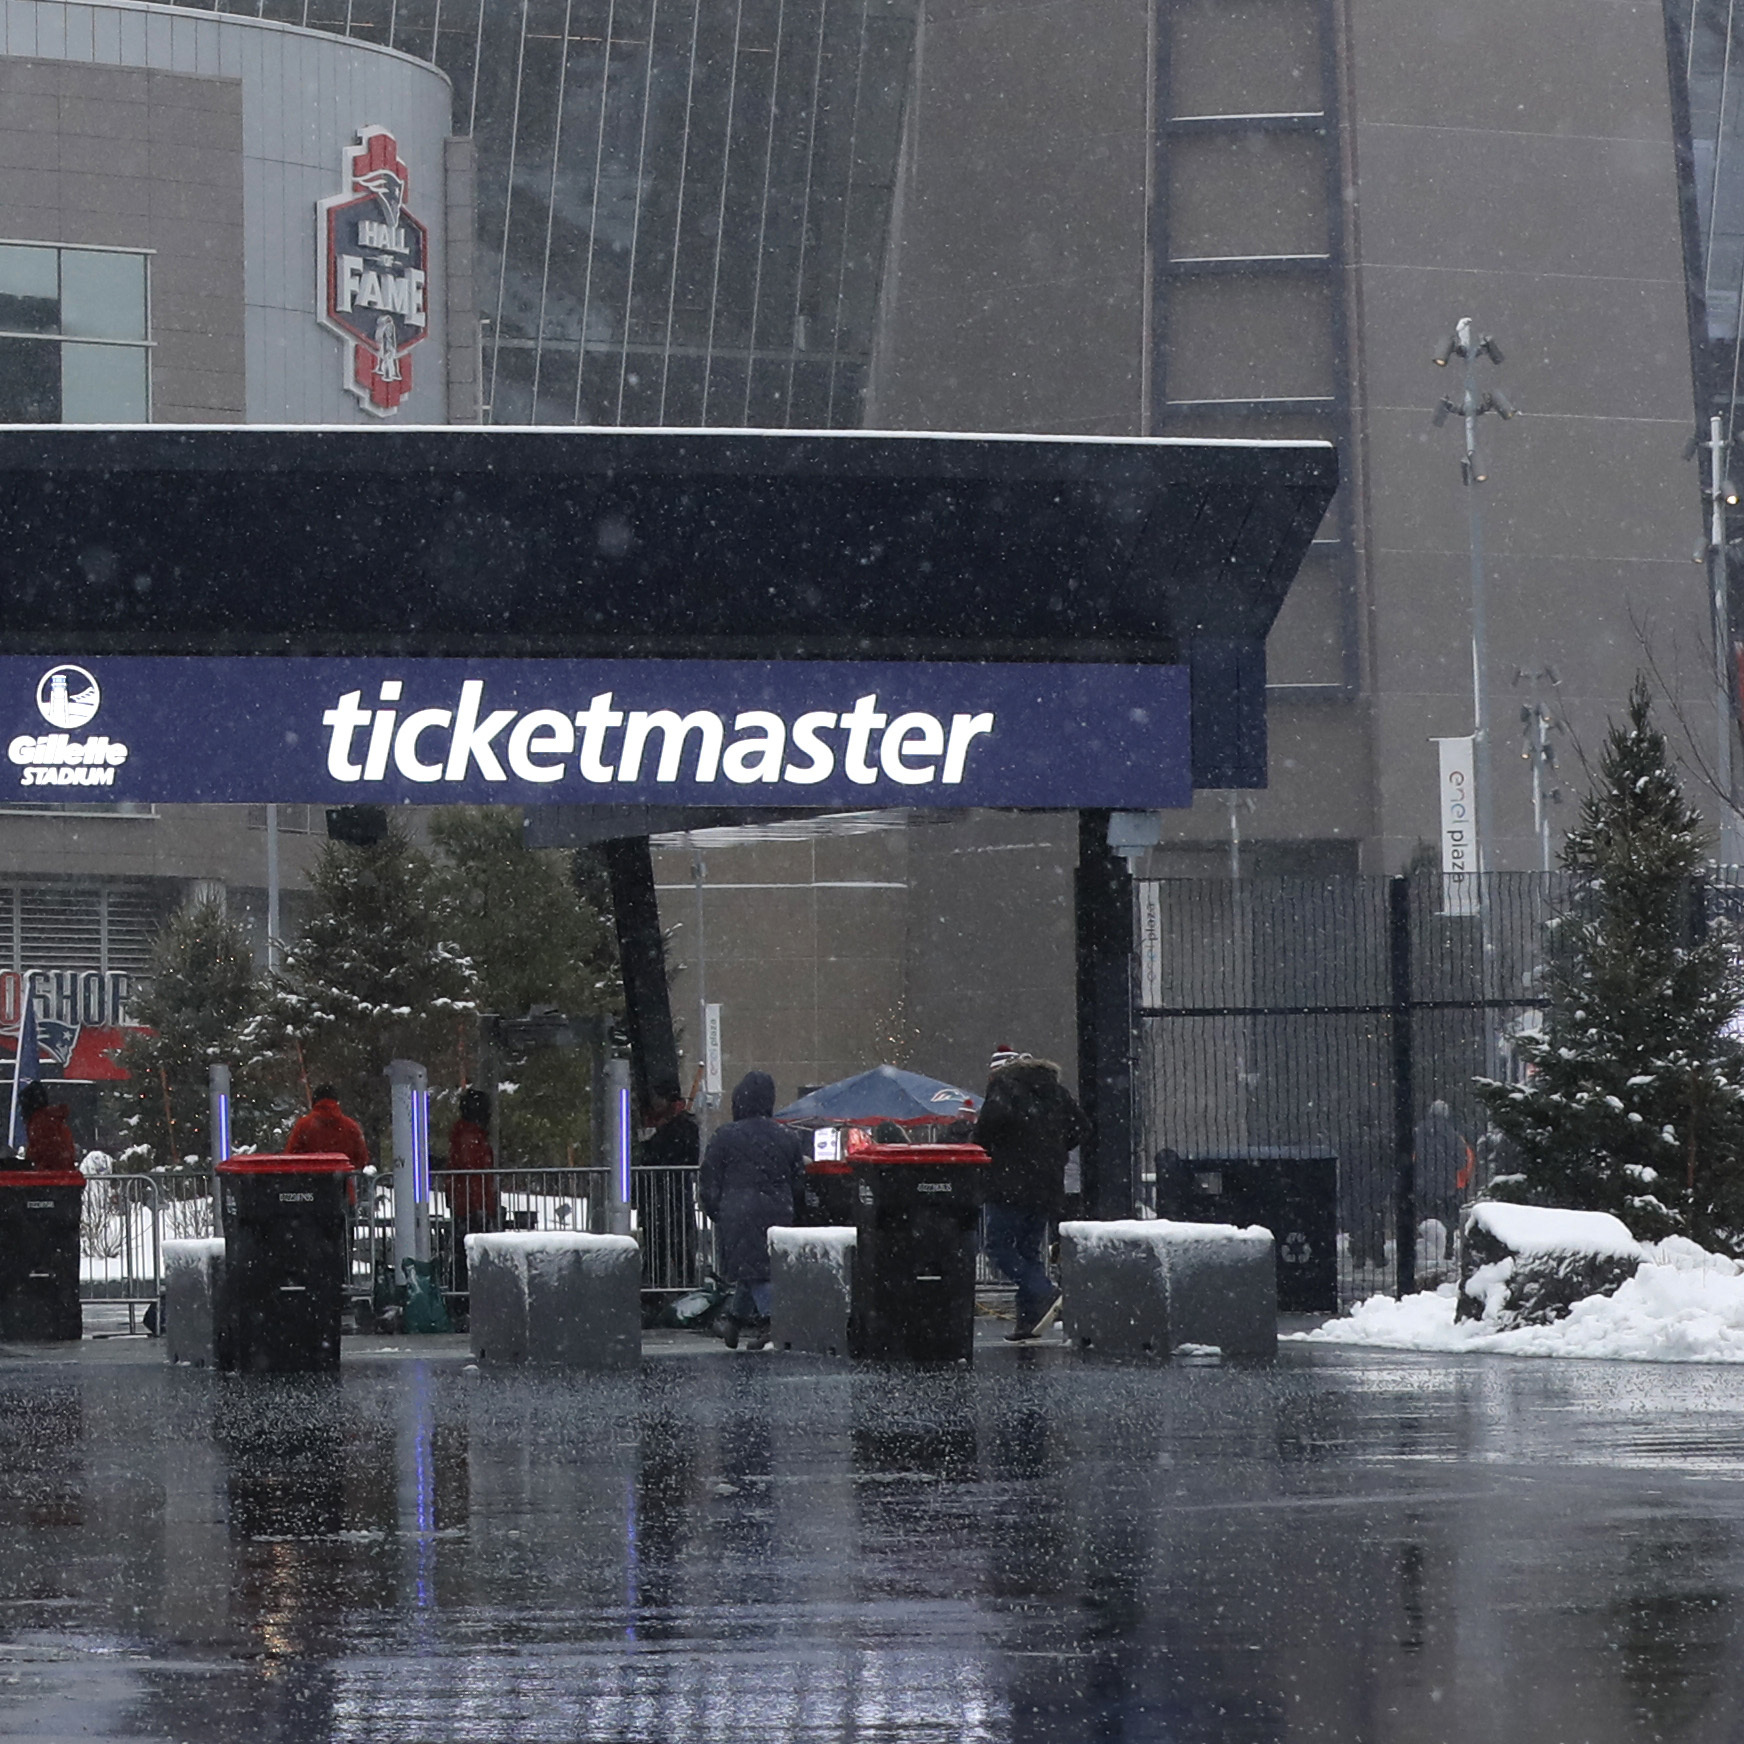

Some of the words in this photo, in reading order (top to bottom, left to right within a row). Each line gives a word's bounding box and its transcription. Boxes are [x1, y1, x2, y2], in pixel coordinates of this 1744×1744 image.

[358, 220, 409, 254] HALL
[335, 254, 426, 328] FAME
[8, 733, 128, 766] Gillette
[322, 680, 994, 785] ticketmaster
[20, 766, 115, 786] STADIUM
[1449, 770, 1469, 823] enel
[1446, 830, 1469, 883] plaza
[23, 970, 132, 1027] SHOP
